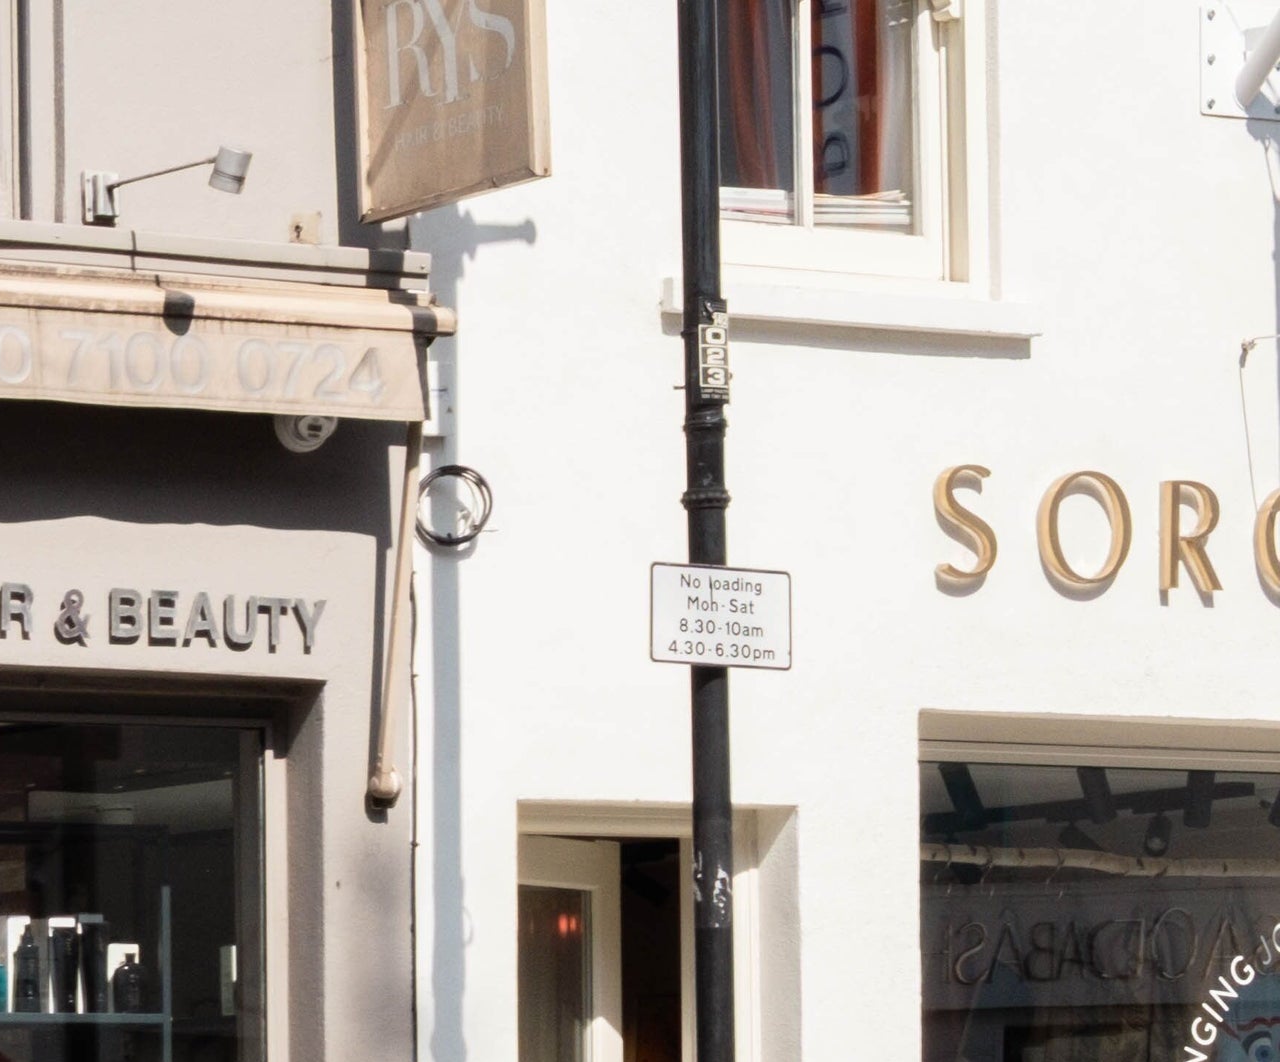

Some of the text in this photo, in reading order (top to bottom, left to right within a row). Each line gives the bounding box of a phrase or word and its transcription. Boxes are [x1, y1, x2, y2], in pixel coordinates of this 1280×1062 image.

[383, 0, 516, 109] RYS
[58, 329, 210, 396] 7100
[235, 336, 388, 403] 0724
[679, 573, 763, 597] No loading
[54, 588, 91, 646] &
[108, 588, 328, 654] BEAUTY
